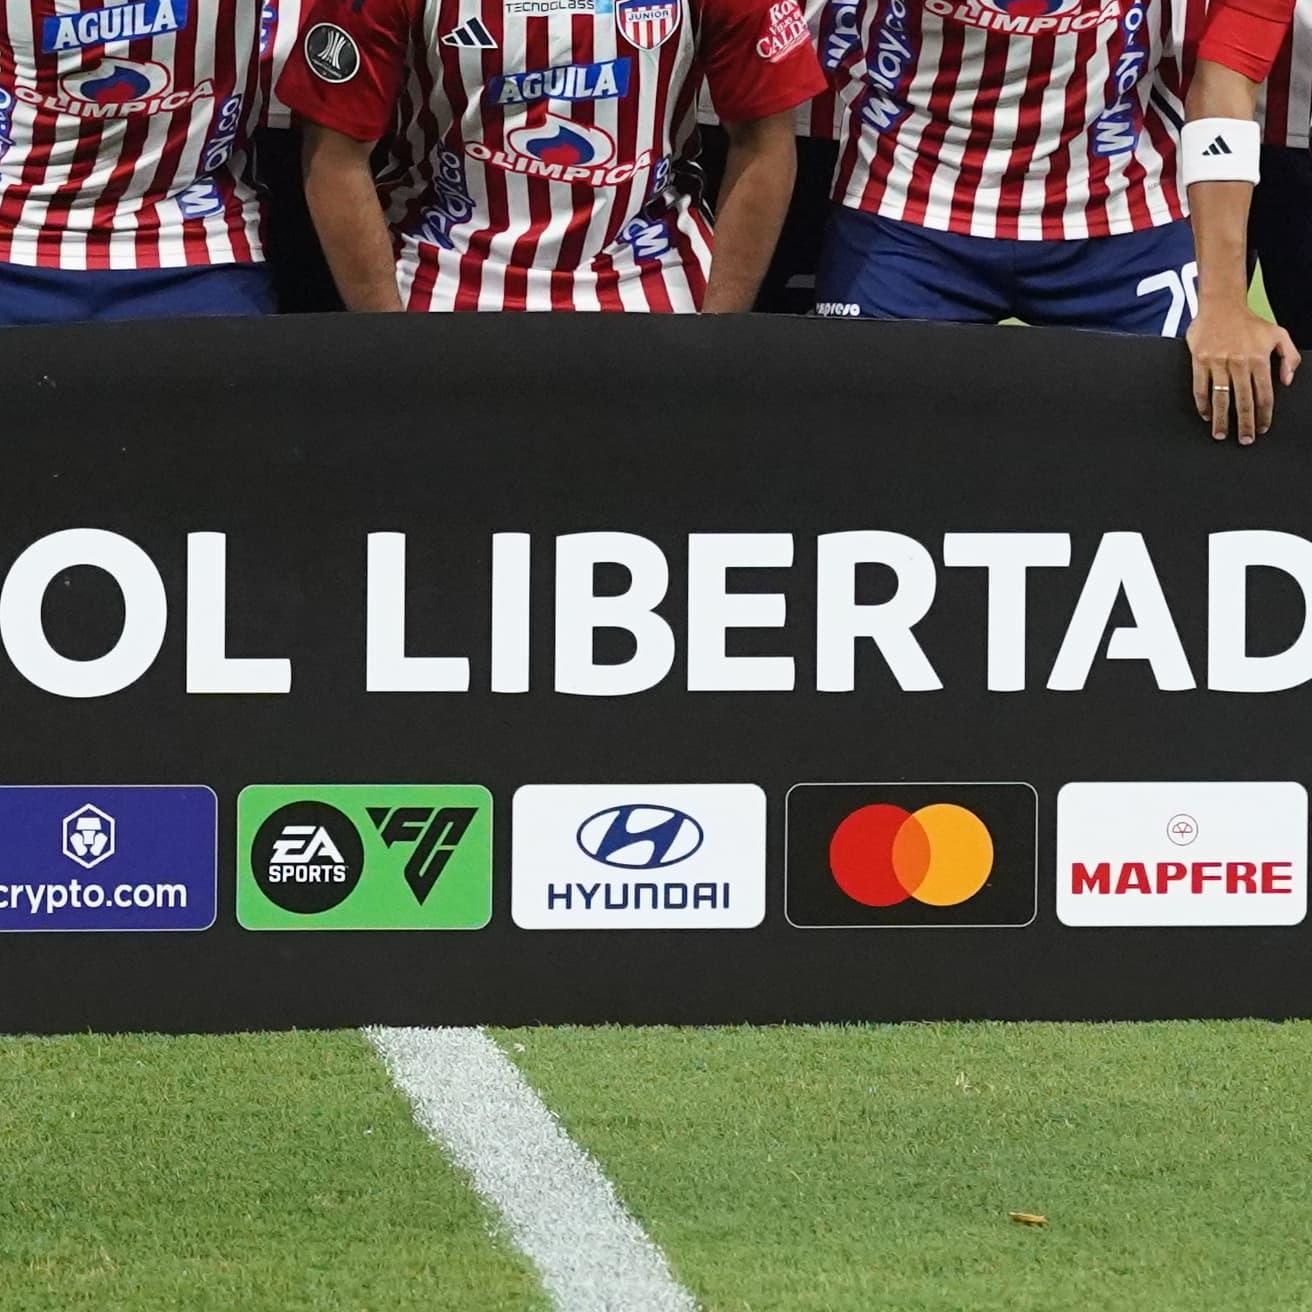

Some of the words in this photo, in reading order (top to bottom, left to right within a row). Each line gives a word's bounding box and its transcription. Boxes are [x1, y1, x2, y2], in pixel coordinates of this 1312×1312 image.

[498, 62, 619, 104] AGUILA
[271, 825, 345, 864] EA
[268, 864, 347, 883] SPORTS
[1070, 861, 1293, 895] MAPFRE
[548, 882, 730, 910] HYUNDAI
